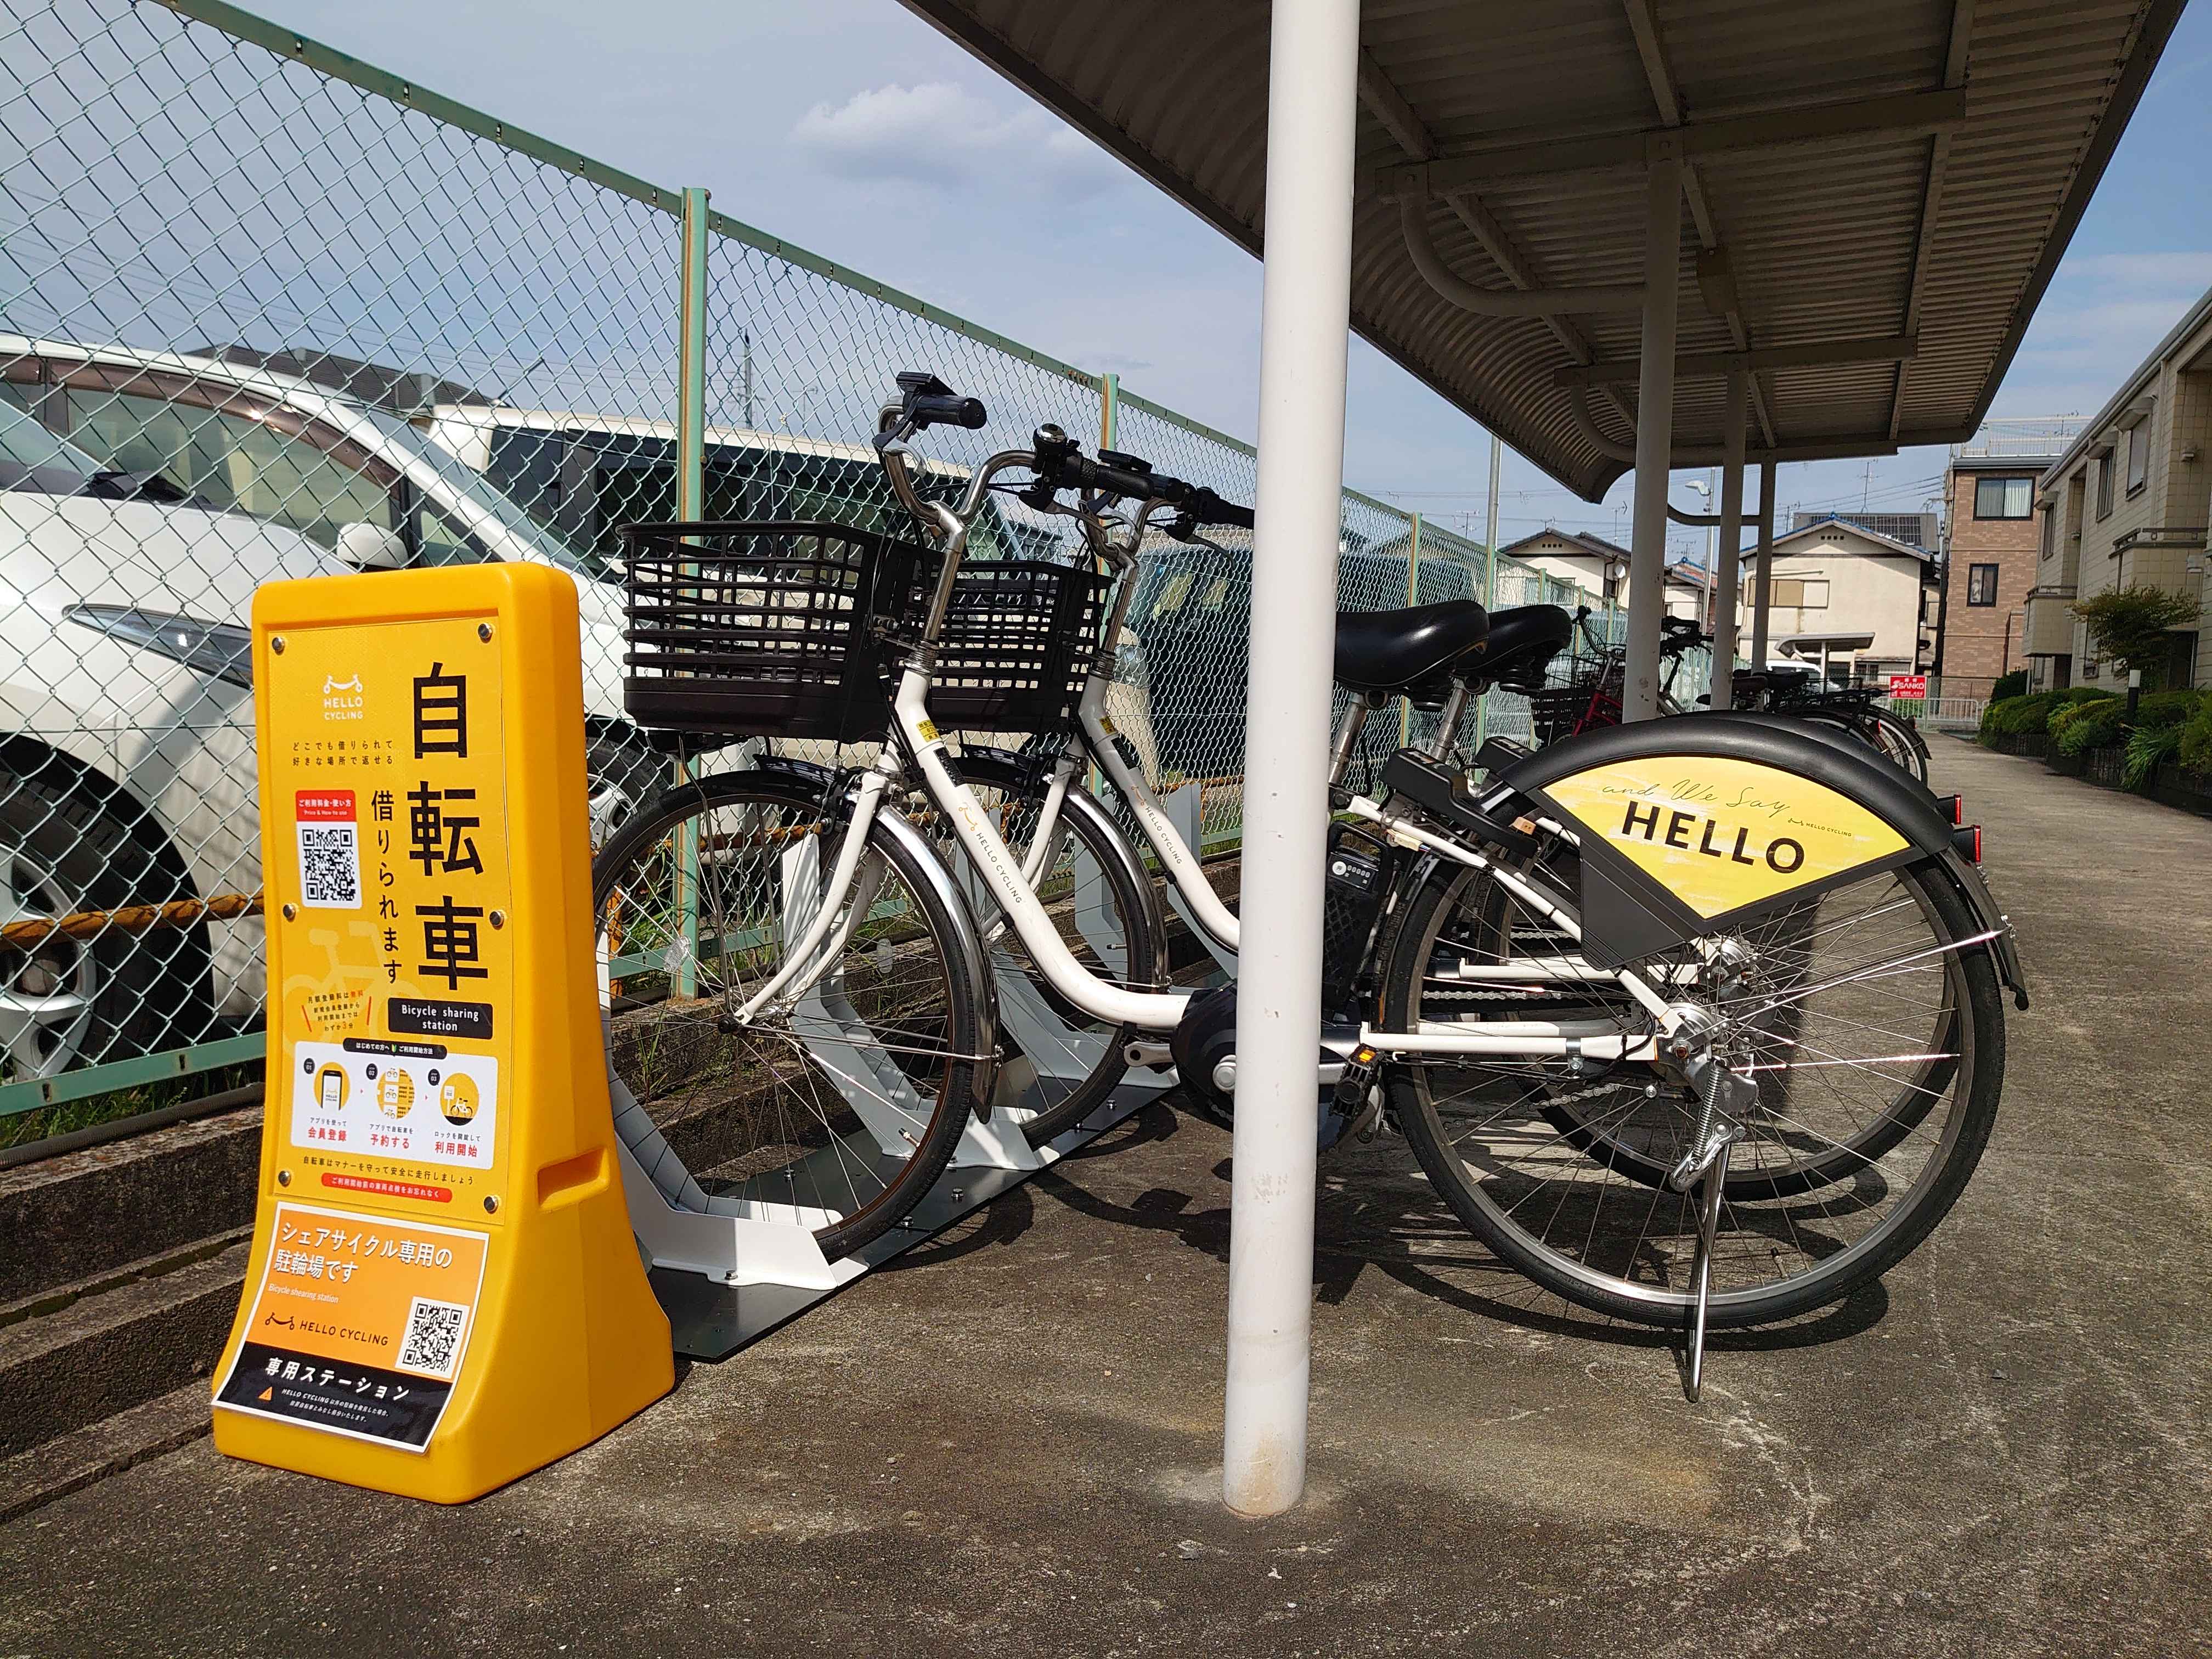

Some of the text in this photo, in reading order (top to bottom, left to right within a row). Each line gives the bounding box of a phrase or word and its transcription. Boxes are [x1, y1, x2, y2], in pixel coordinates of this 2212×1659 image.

[324, 697, 363, 708] HELLO
[324, 711, 363, 720] CYCLING
[292, 740, 392, 751] どこでも借りられて
[292, 755, 392, 766] 好きな場所で返せる
[1602, 779, 1791, 818] and We Say
[407, 662, 488, 990] 自転車
[1827, 827, 1852, 837] CYCLING
[1145, 806, 1182, 864] HELLO CYCLING
[1622, 800, 1805, 874] HELLO
[976, 833, 1022, 903] HELLO CYCLING
[371, 790, 402, 984] 借りられます
[402, 1005, 479, 1022] Bicycle sharing
[422, 1020, 458, 1031] station
[356, 1042, 390, 1051] はじめての方へ
[308, 1126, 347, 1142] 会員登録
[369, 1124, 413, 1135] アプリで自転車を
[370, 1133, 409, 1149] 予約する
[435, 1141, 478, 1158] 利用開始
[303, 1156, 473, 1185] 自転車はマナーを守って安全に走行しましょう
[281, 1222, 453, 1268] シェアサイクル専用の
[274, 1249, 358, 1283] 駐輪場です
[269, 1283, 338, 1303] Bicycle shearing station
[300, 1320, 388, 1346] HELLO CYCLING
[264, 1357, 410, 1401] 専用ステーション
[281, 1389, 302, 1397] HELLO
[302, 1392, 329, 1404] CYCLING
